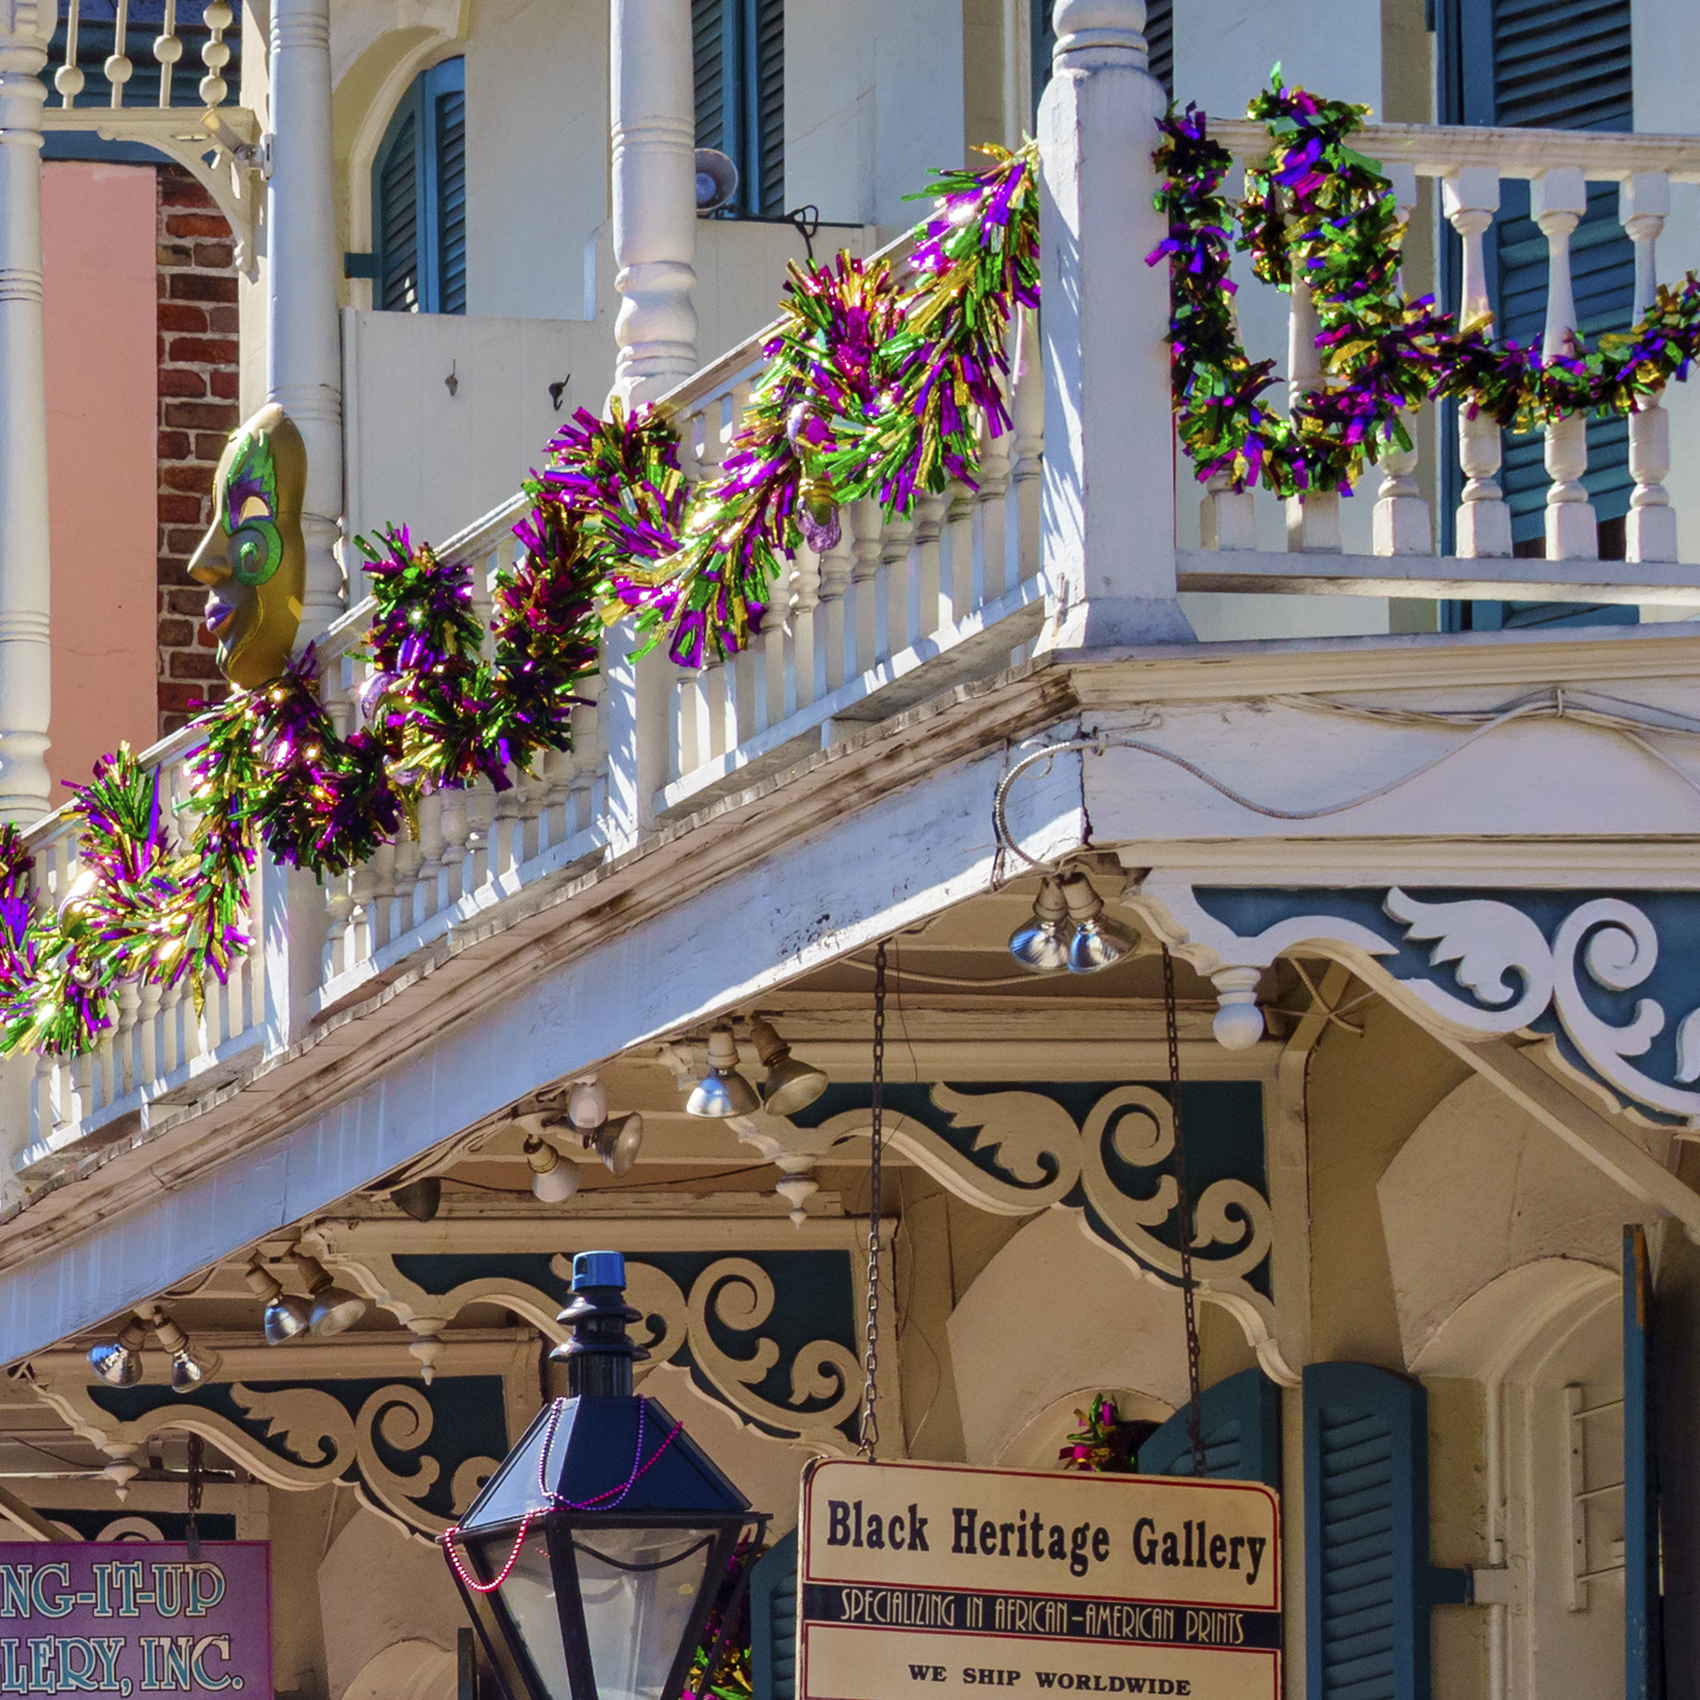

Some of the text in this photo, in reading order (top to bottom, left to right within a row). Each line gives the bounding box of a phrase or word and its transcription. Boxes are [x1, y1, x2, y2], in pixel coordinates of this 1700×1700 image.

[827, 1499, 1267, 1585] Black Heritage Gallery
[841, 1588, 954, 1628] SPECIALIZING
[966, 1597, 983, 1628] IN
[1186, 1609, 1244, 1645] PRINTS
[140, 1633, 245, 1692] INC.
[908, 1664, 1191, 1696] WE SHIP WORLDWIDE
